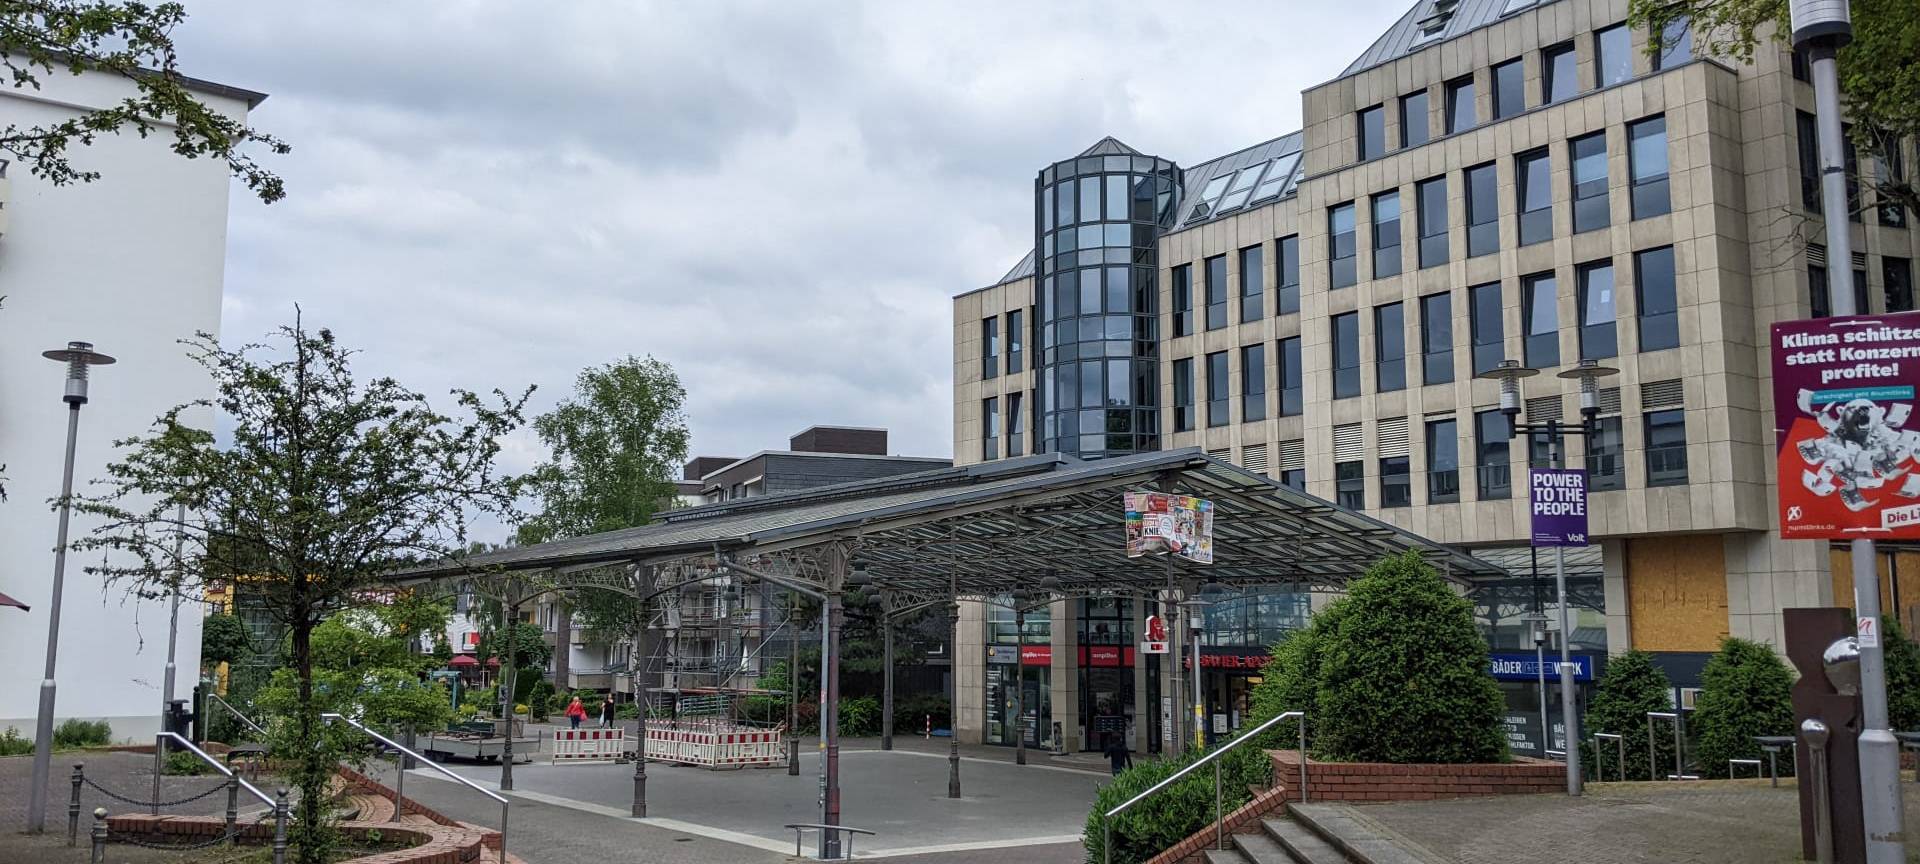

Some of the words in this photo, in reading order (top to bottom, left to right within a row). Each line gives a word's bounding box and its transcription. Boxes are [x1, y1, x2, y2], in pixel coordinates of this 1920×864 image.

[1782, 333, 1839, 348] Klima
[1786, 349, 1836, 365] statt
[1821, 363, 1899, 384] profite!
[1533, 473, 1583, 487] POWER
[1534, 487, 1555, 502] TO
[1556, 487, 1584, 502] THE
[1534, 502, 1585, 516] PEOPLE
[1887, 511, 1908, 523] Die
[1567, 533, 1585, 542] Volt
[1491, 658, 1522, 674] BÄDER
